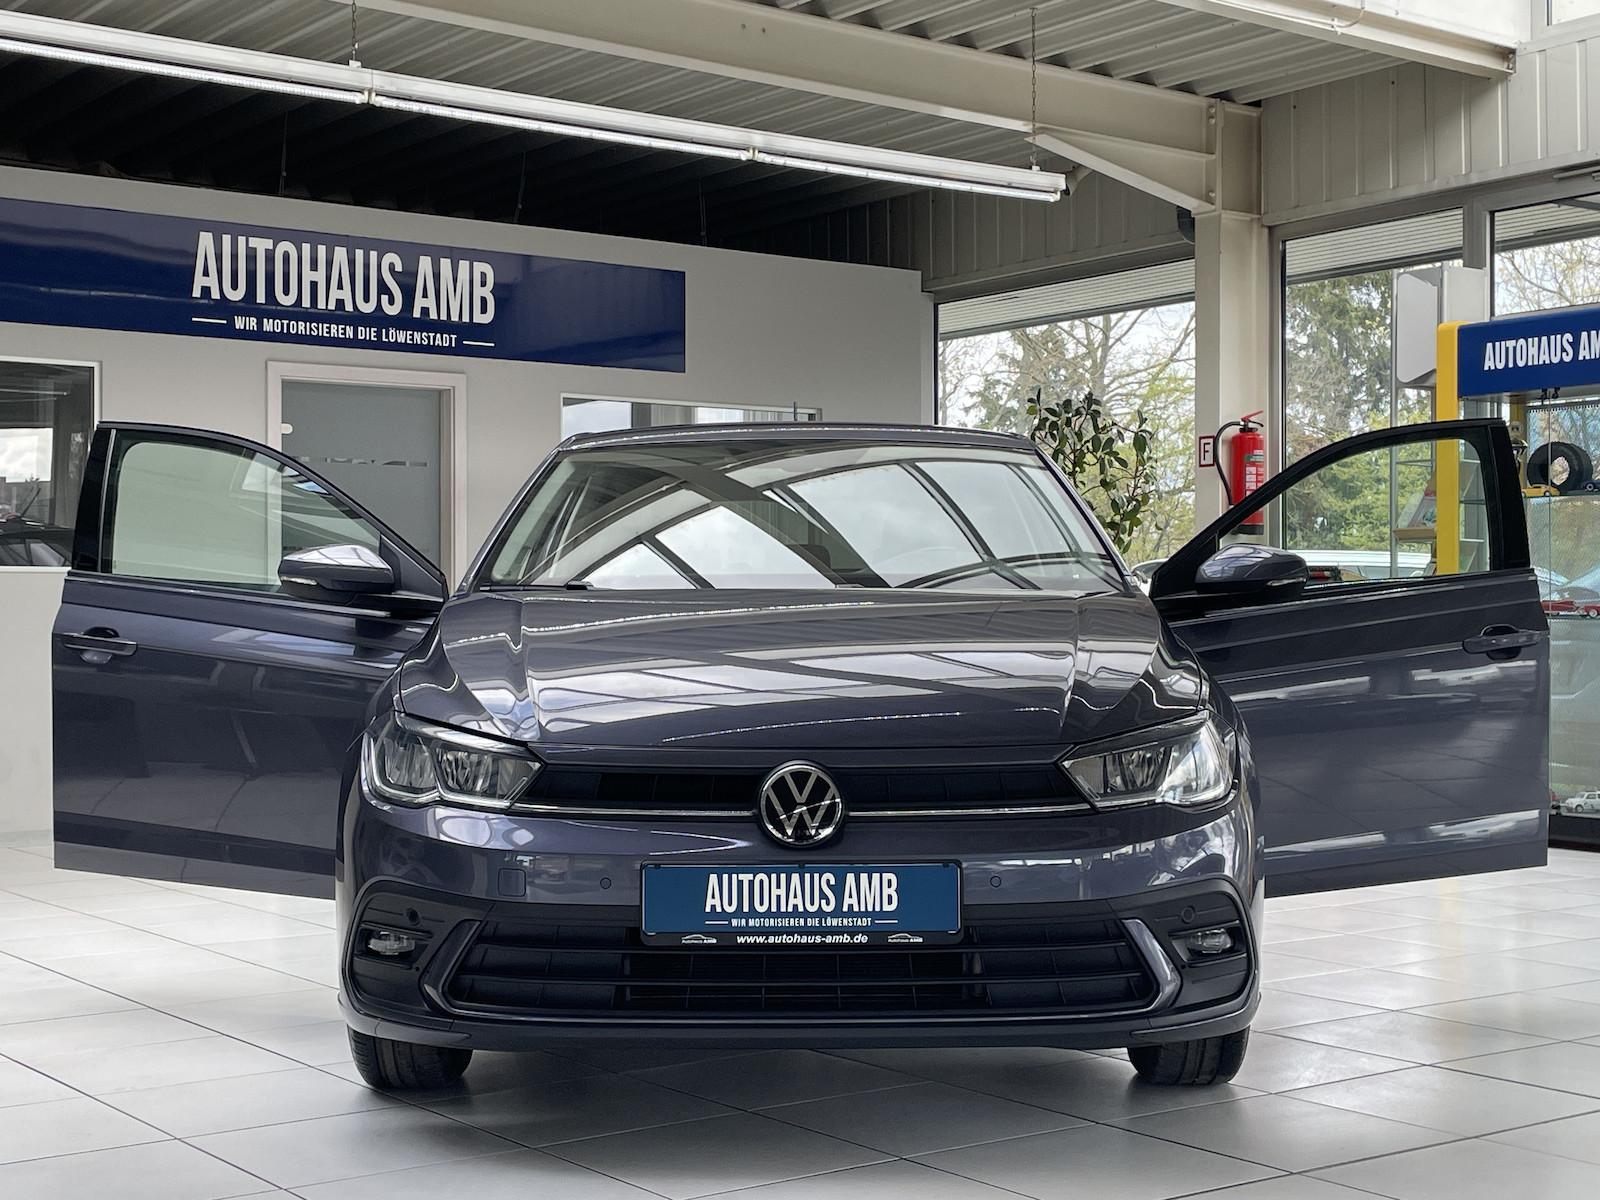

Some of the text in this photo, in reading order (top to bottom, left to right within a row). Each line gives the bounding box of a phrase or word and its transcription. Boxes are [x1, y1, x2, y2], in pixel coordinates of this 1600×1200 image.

[192, 231, 496, 325] AUTOHAUS AMB
[234, 315, 458, 348] WIR MOTORISIEREN DIE LÖWENSTADT
[1483, 332, 1574, 371] AUTOHAUS
[705, 872, 898, 913] AUTOHAUS AMB
[731, 916, 872, 927] WIR MOTORISIEREN DIE LÖWENSTADT
[736, 933, 868, 944] www.autohaus-amb.de
